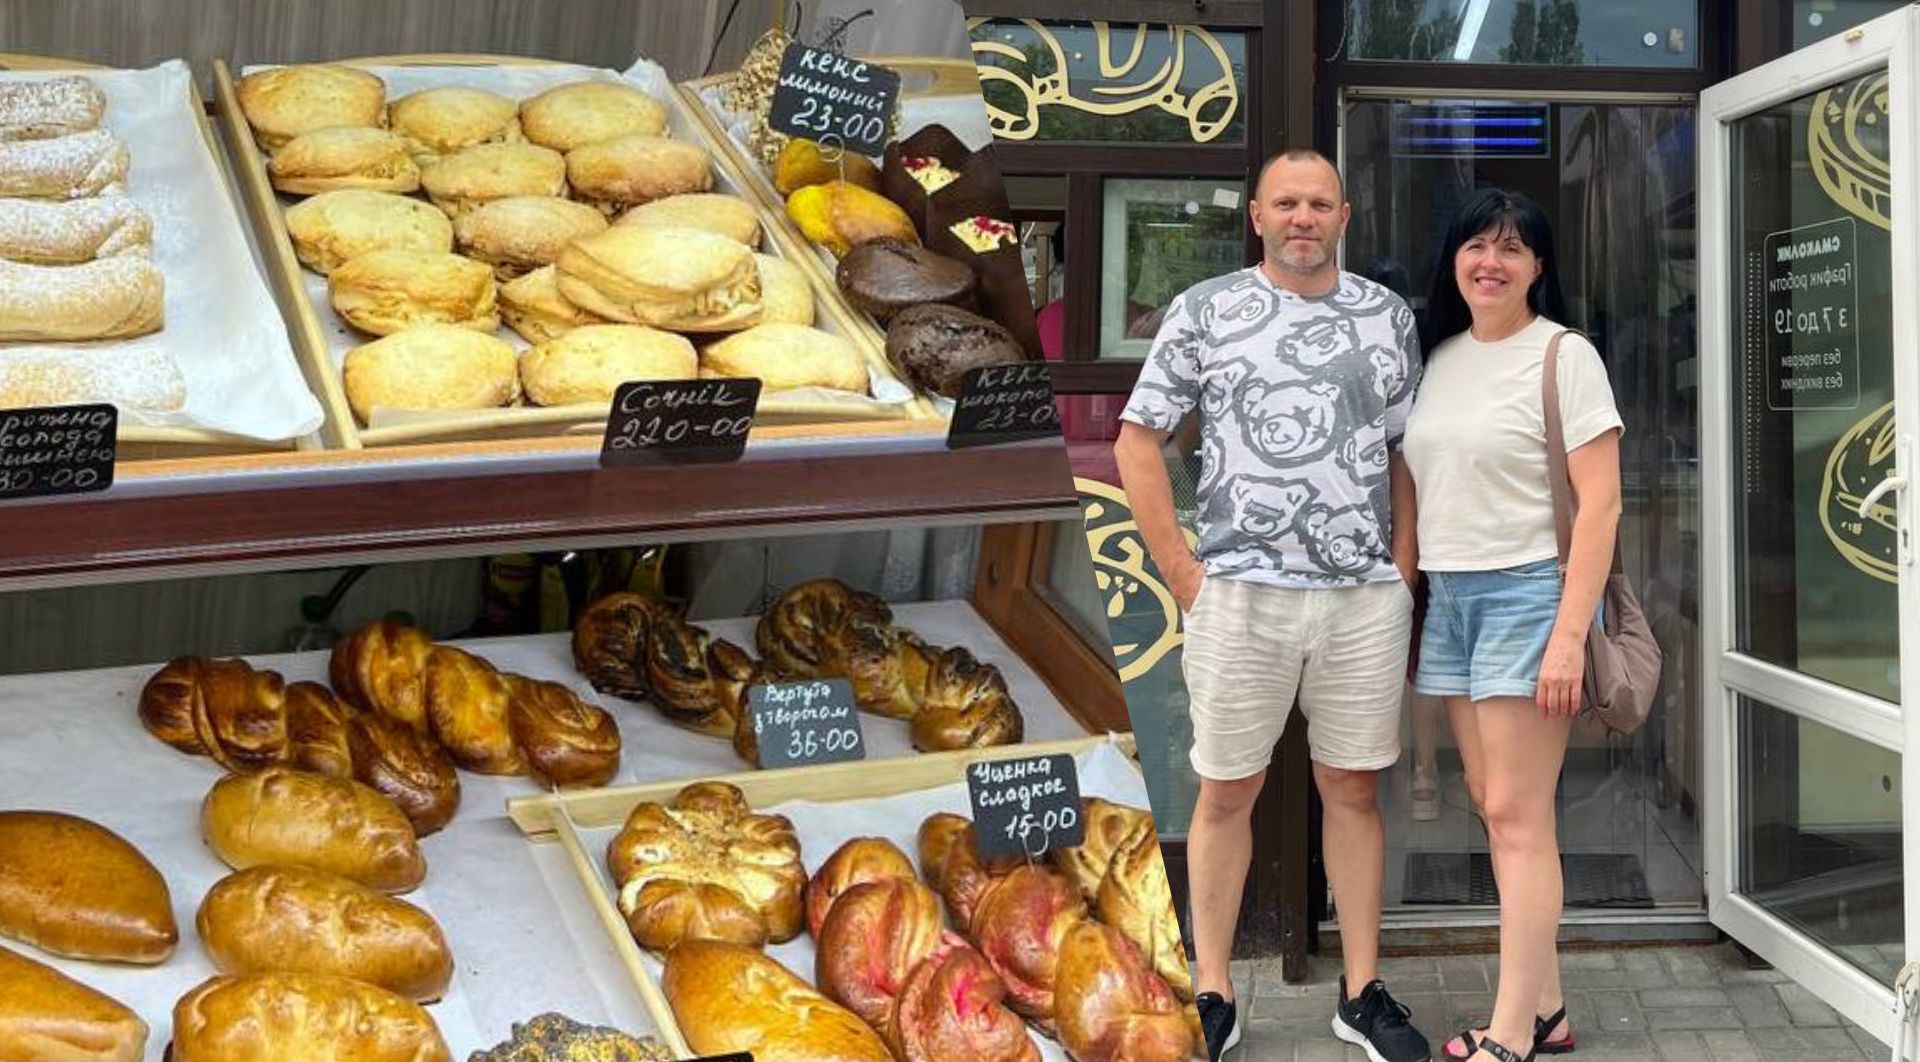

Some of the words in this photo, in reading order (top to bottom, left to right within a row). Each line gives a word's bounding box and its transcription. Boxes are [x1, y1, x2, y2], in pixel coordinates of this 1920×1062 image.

[791, 97, 884, 143] 23-00
[611, 416, 753, 449] 220-00
[787, 727, 859, 759] 36-00
